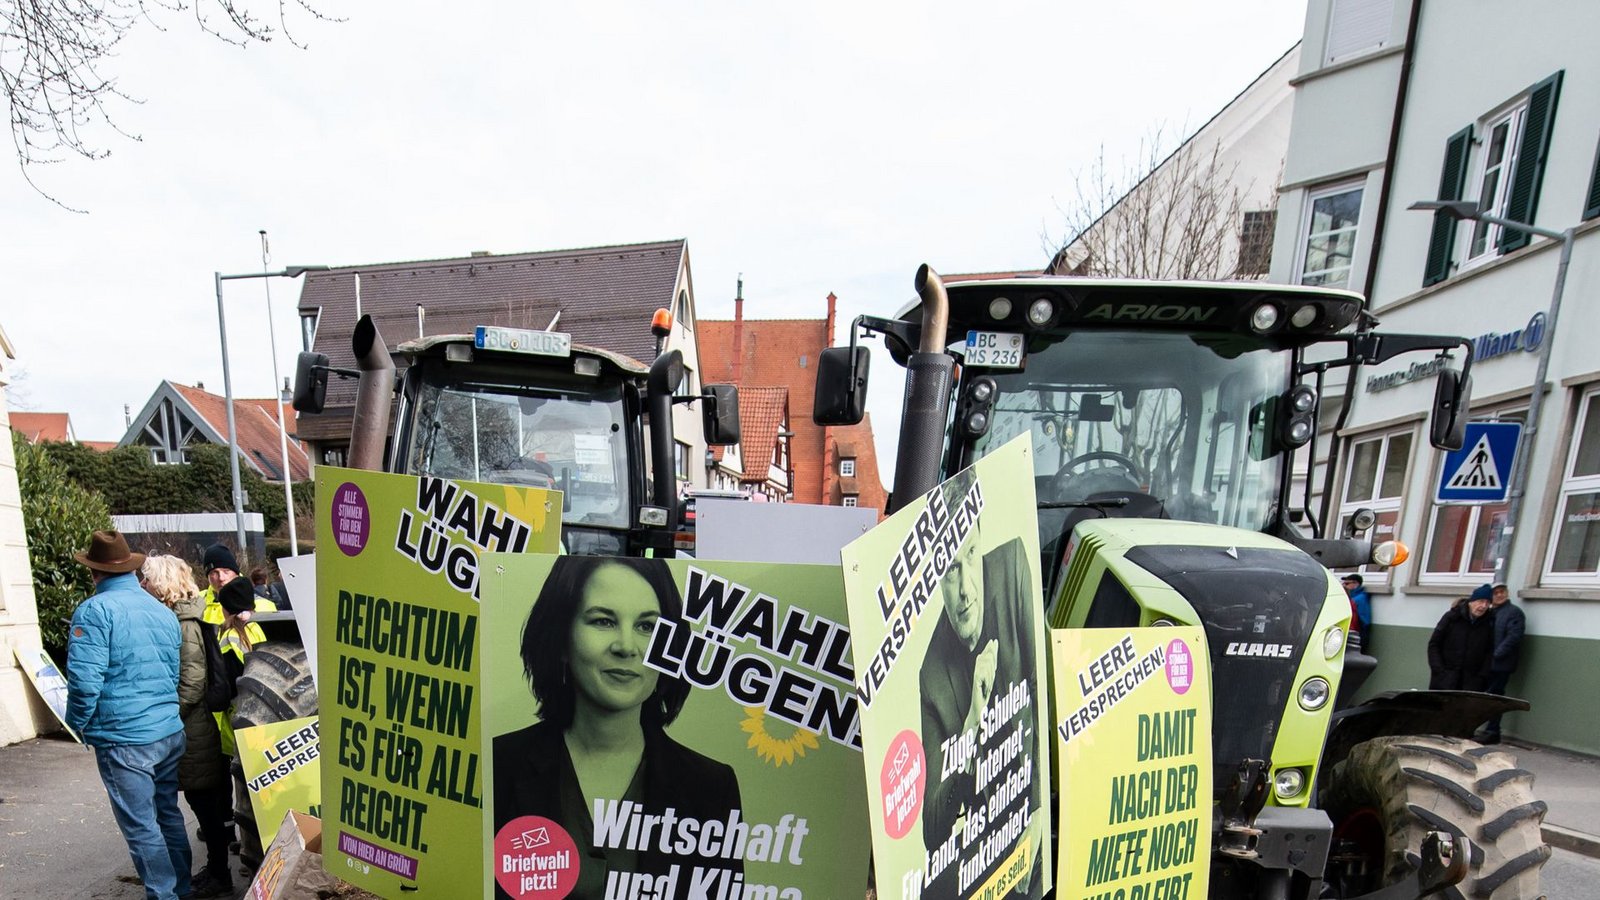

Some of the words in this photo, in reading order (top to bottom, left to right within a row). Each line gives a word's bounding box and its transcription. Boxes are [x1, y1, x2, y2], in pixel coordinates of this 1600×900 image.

[979, 334, 996, 348] BC
[1083, 304, 1217, 321] ARION
[967, 349, 986, 364] MS
[991, 350, 1018, 365] 236
[343, 490, 357, 504] ALLE
[396, 511, 481, 599] LÜG
[877, 486, 948, 622] LEERE
[686, 570, 855, 682] WAHL
[857, 481, 984, 707] VERSPRECHEN!
[336, 590, 478, 672] REICHTUM
[1225, 642, 1293, 658] CLAAS
[337, 655, 376, 721] IST,
[385, 666, 474, 739] WENN
[1058, 646, 1165, 742] VERSPRECHEN!
[1078, 636, 1136, 697] LEERE
[940, 728, 977, 782] Züge,
[979, 678, 1031, 745] Schulen,
[976, 720, 1024, 795] Internet
[1137, 708, 1196, 762] DAMIT
[338, 717, 367, 773] ES
[371, 723, 423, 789] FÜR
[427, 744, 482, 809] ALL
[886, 753, 921, 817] Briefwahl
[1109, 770, 1161, 825] NACH
[1164, 764, 1198, 814] DER
[340, 776, 428, 853] REICHT.
[593, 798, 809, 866] Wirtschaft
[897, 783, 917, 832] jetzt!
[924, 824, 960, 889] Land,
[962, 804, 986, 849] das
[988, 753, 1032, 824] einfach
[342, 835, 358, 855] VON
[357, 841, 374, 862] HIER
[375, 849, 386, 866] AN
[387, 854, 412, 876] GRÜN.
[503, 850, 570, 874] Briefwahl
[520, 872, 557, 895] jetzt!
[604, 864, 681, 900] und
[996, 874, 1007, 897] es
[1007, 853, 1027, 885] seid.
[1085, 829, 1148, 887] MIETE
[1146, 818, 1199, 873] NOCH
